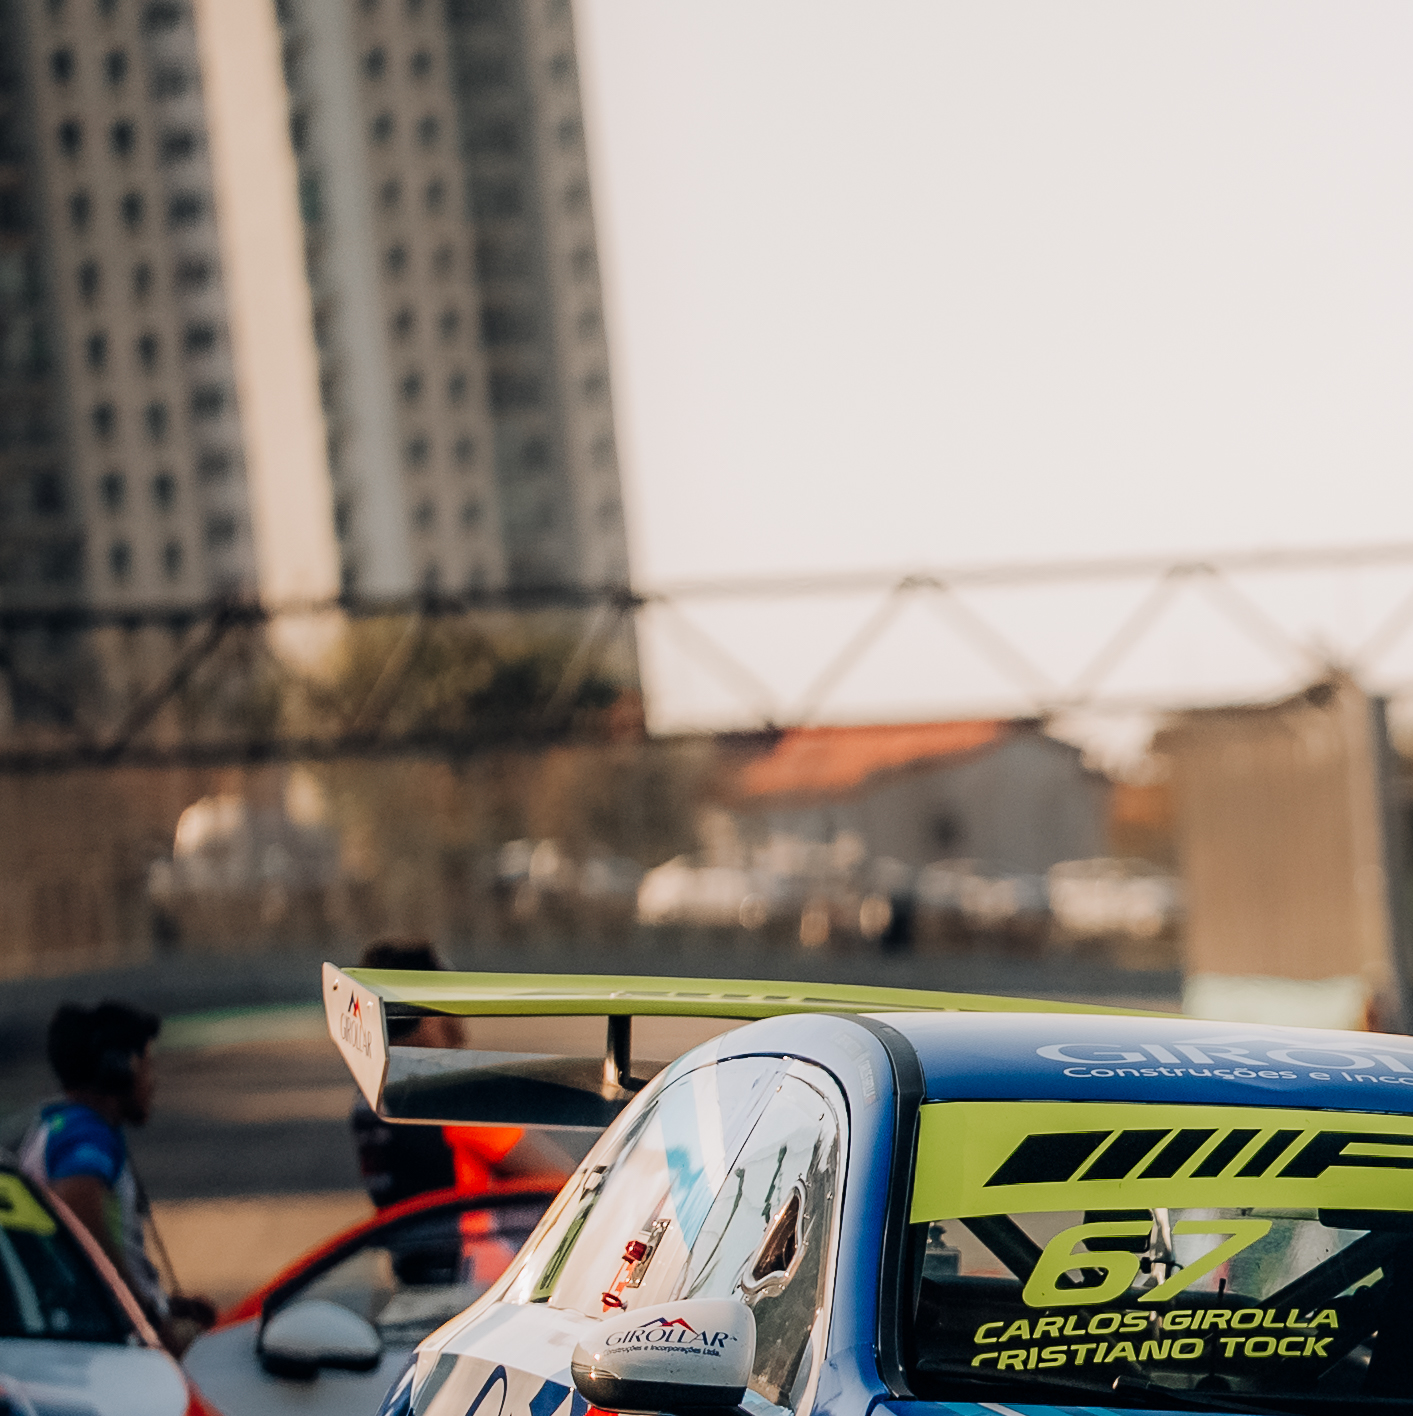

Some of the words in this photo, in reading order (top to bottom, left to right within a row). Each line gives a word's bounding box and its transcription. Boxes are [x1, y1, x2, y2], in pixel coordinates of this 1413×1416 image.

[1063, 1066, 1298, 1080] Construções
[1309, 1071, 1331, 1081] e
[1022, 1219, 1273, 1308] 67
[973, 1311, 1151, 1345] CARLOS
[1162, 1308, 1339, 1331] GIROLLA
[606, 1329, 729, 1348] GIROLLAR
[1220, 1336, 1334, 1358] TOCK
